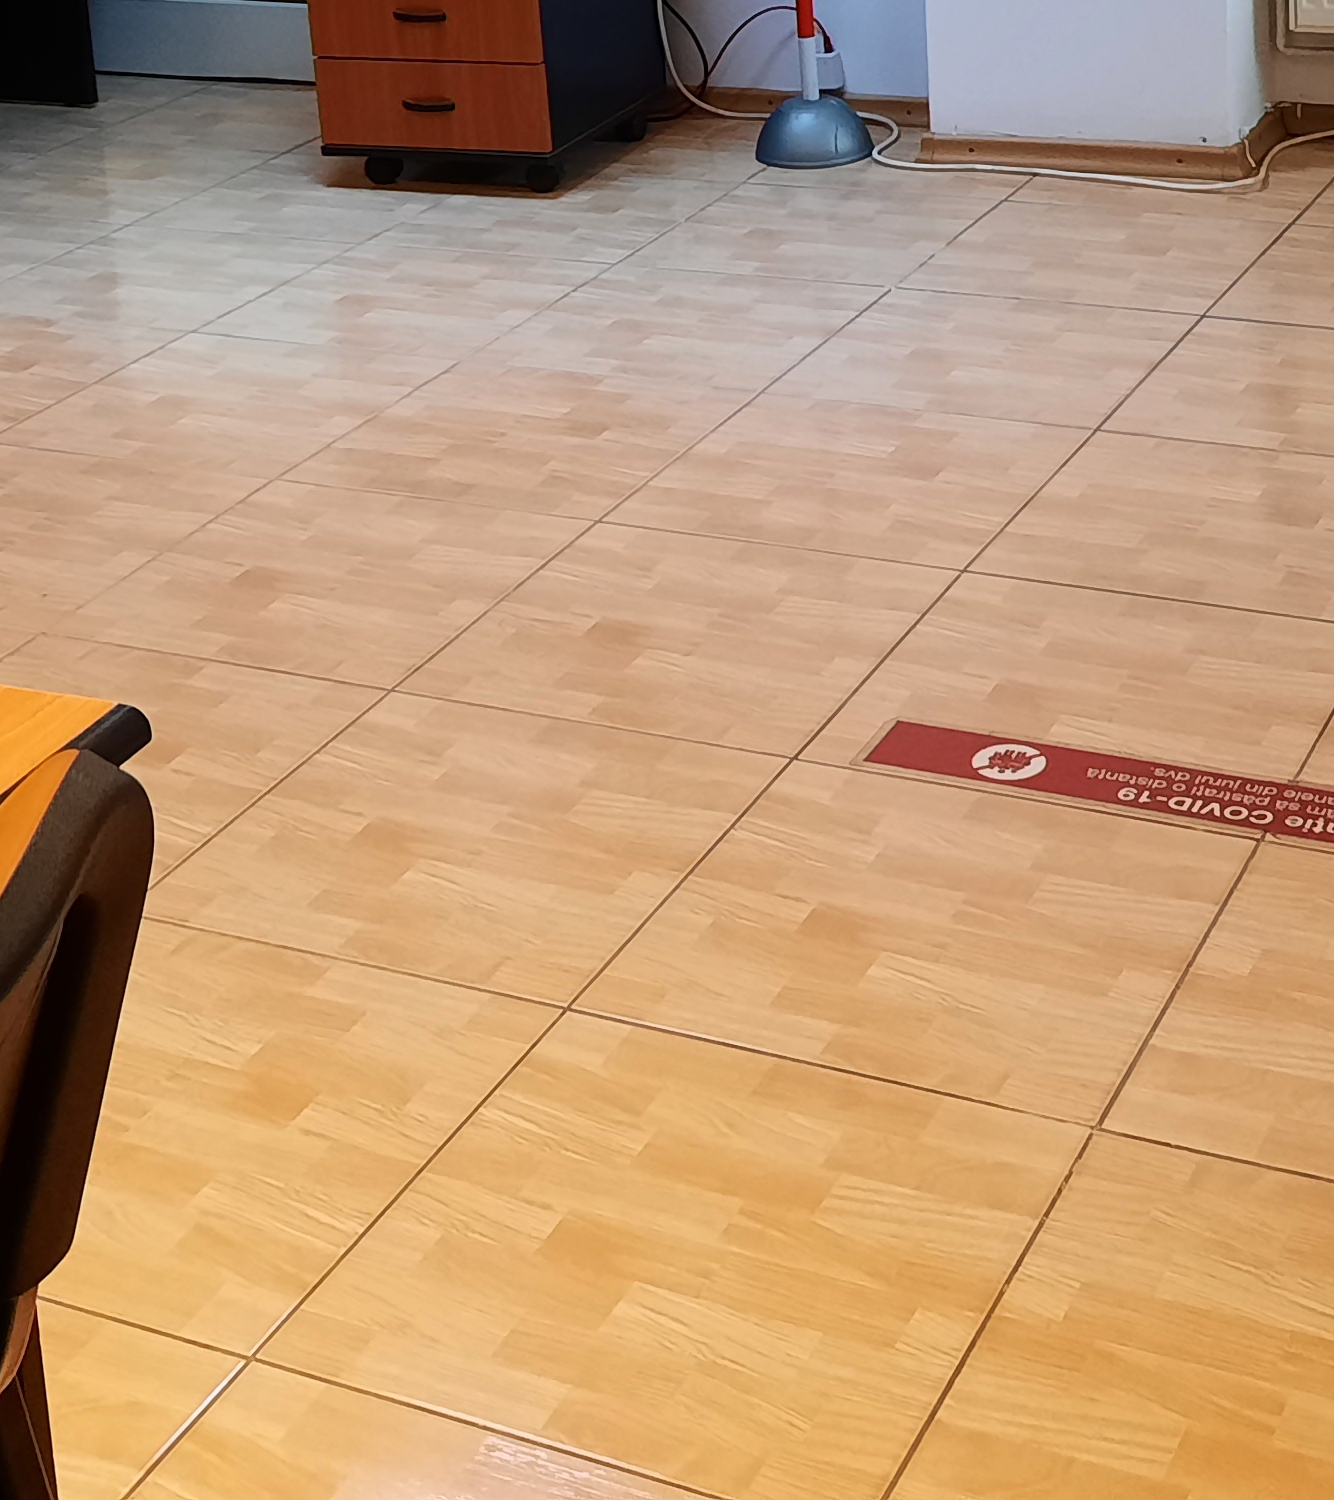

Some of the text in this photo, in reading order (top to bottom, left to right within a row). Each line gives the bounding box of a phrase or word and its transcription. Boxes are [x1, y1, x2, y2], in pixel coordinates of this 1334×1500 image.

[1149, 765, 1192, 782] dvs.
[1171, 782, 1187, 793] o
[1194, 773, 1243, 793] jurul
[1244, 781, 1278, 798] din
[1116, 786, 1275, 825] COVID-19
[1275, 799, 1301, 813] să
